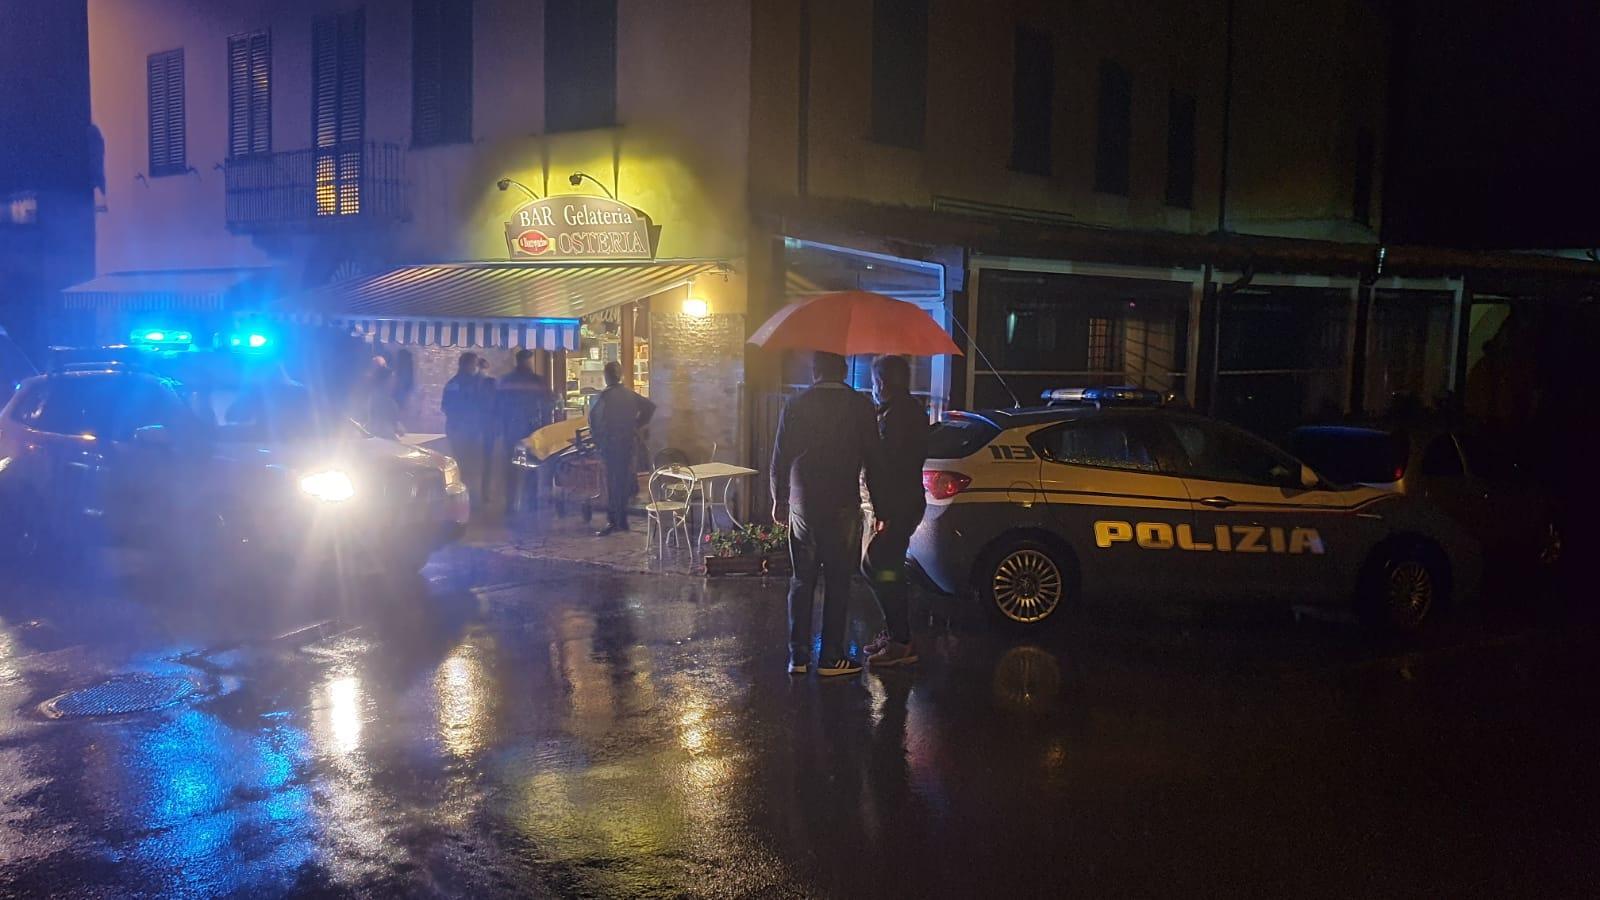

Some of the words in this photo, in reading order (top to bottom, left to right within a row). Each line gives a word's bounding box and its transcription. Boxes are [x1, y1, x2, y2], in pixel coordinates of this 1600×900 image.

[520, 206, 556, 227] BAR
[564, 204, 633, 226] Gelateria
[559, 231, 647, 255] OSTERIA
[988, 445, 1035, 460] 113
[1094, 520, 1325, 555] POLIZIA
